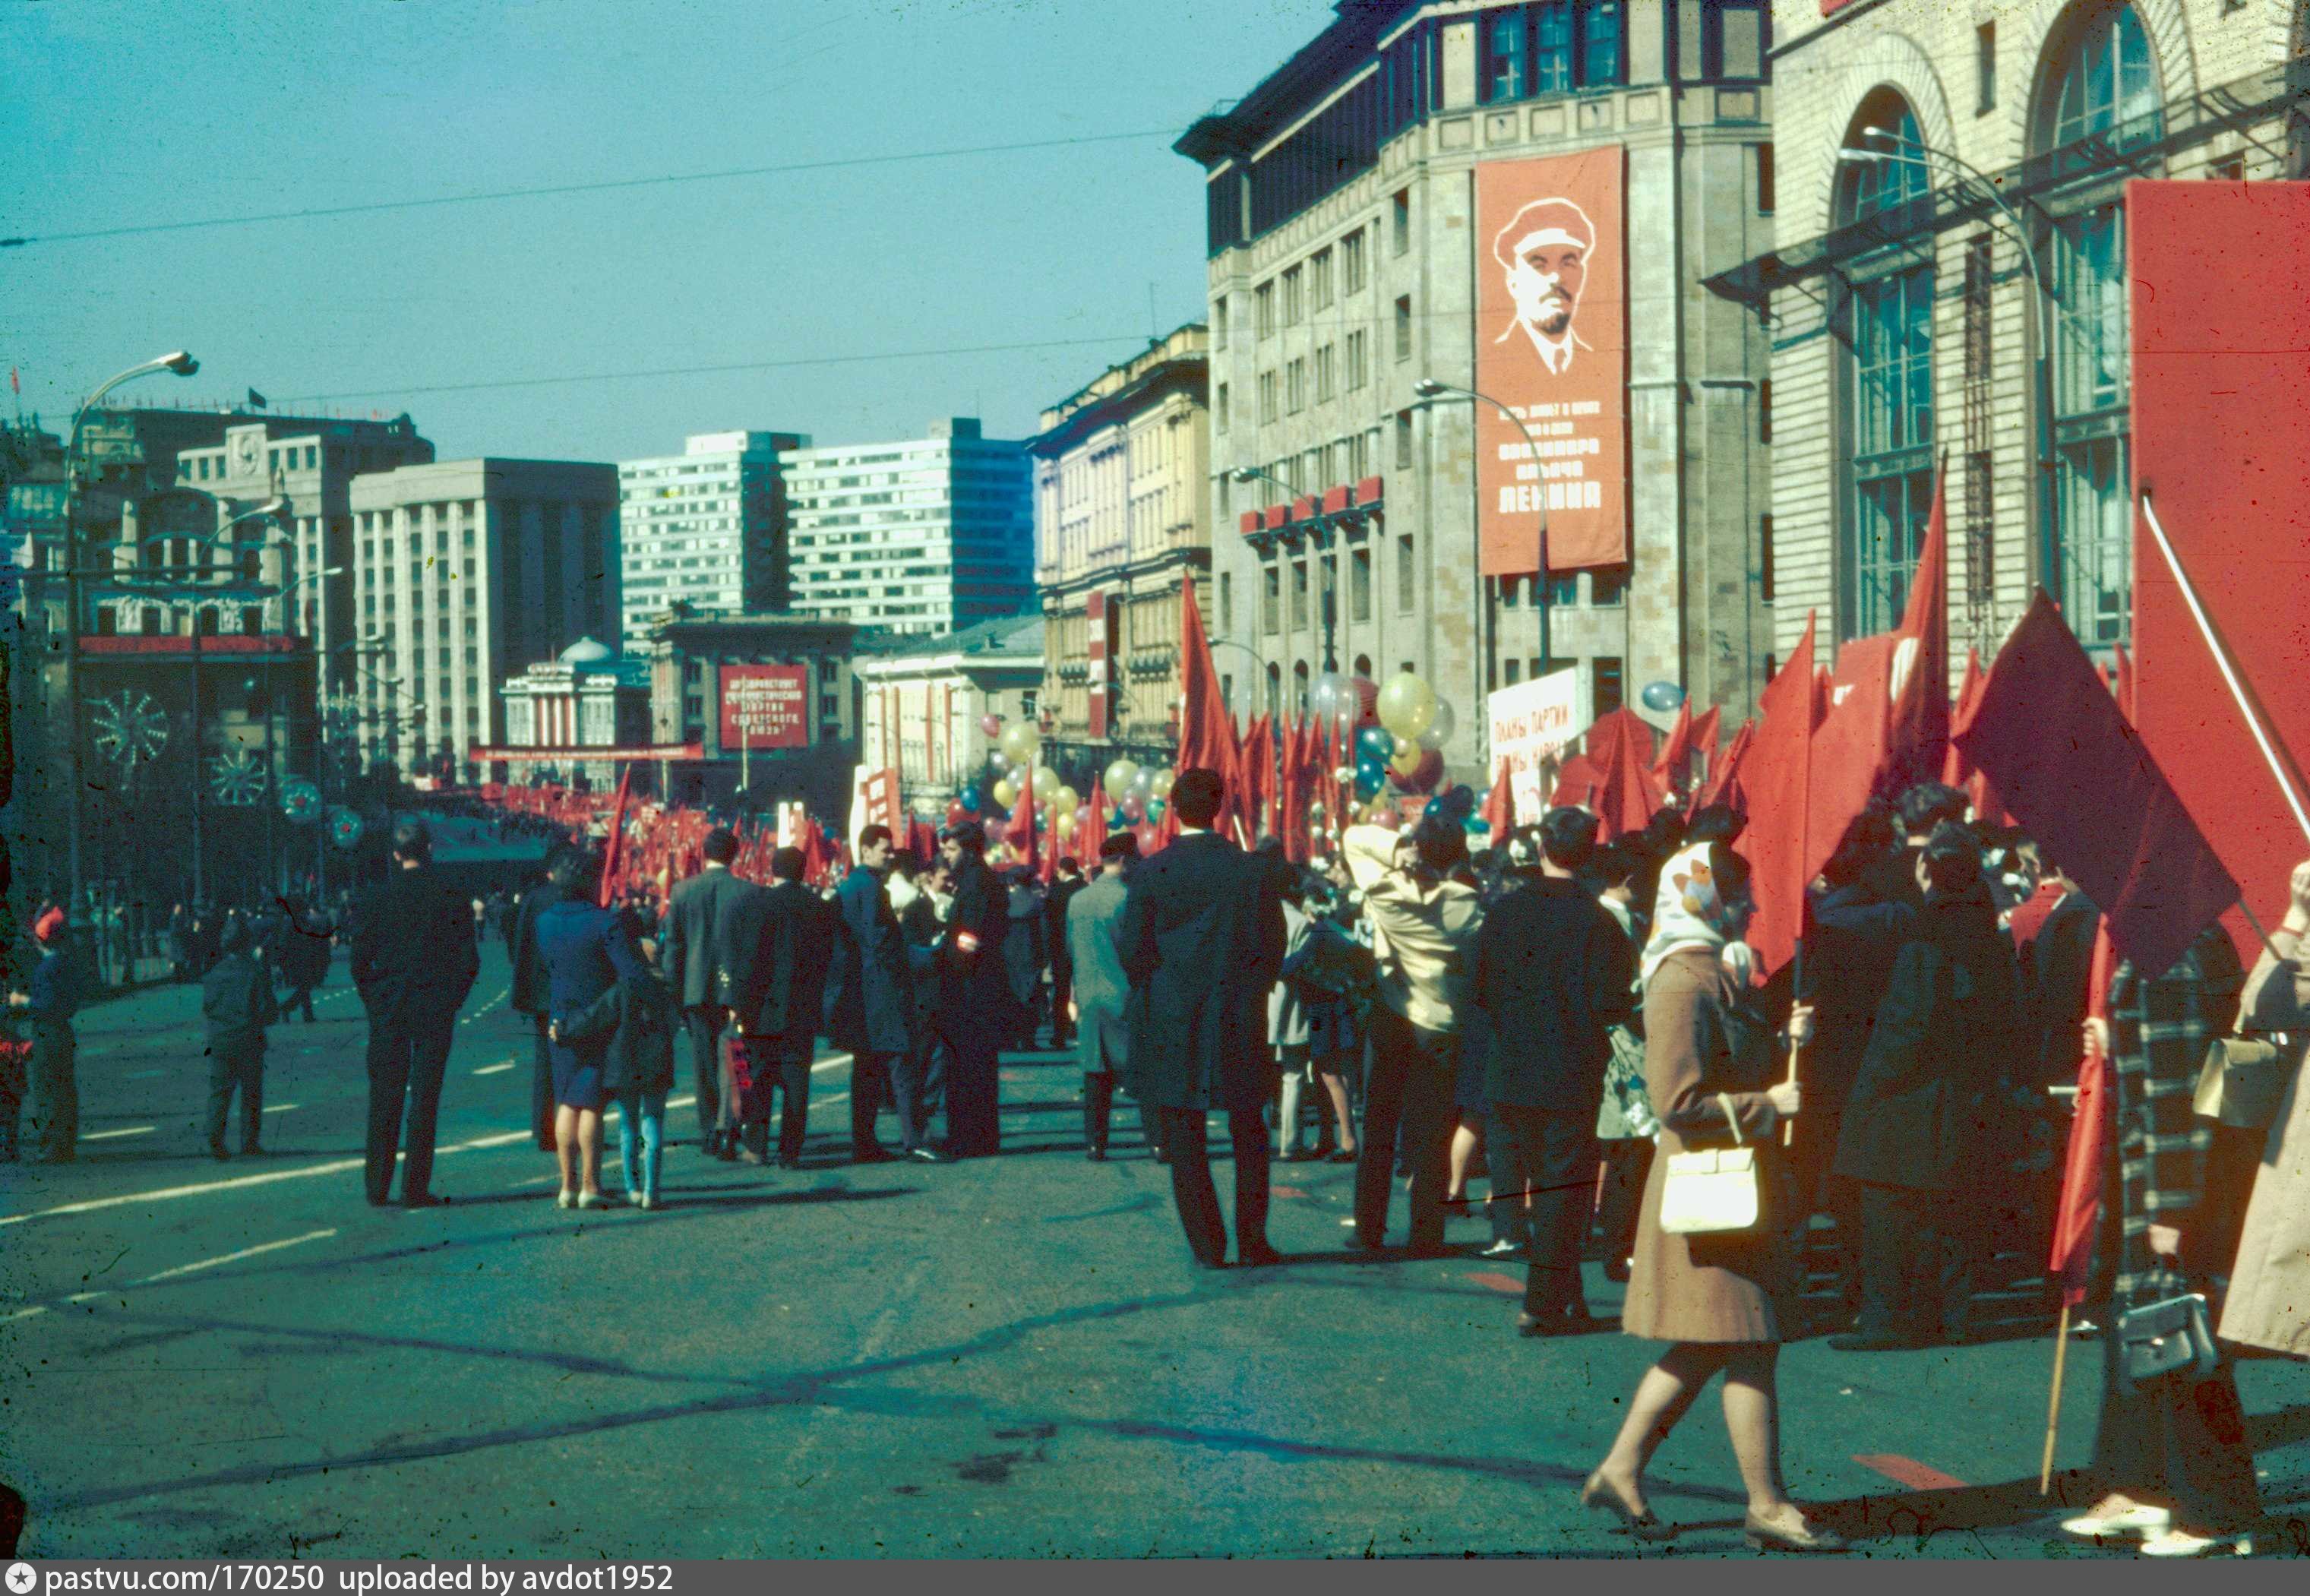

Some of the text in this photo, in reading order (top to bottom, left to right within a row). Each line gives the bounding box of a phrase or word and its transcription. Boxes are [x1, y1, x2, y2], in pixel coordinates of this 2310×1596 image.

[1499, 481, 1601, 514] ЛЕНИНА
[1495, 704, 1568, 742] ПЛАНЫ ПАРТИИ
